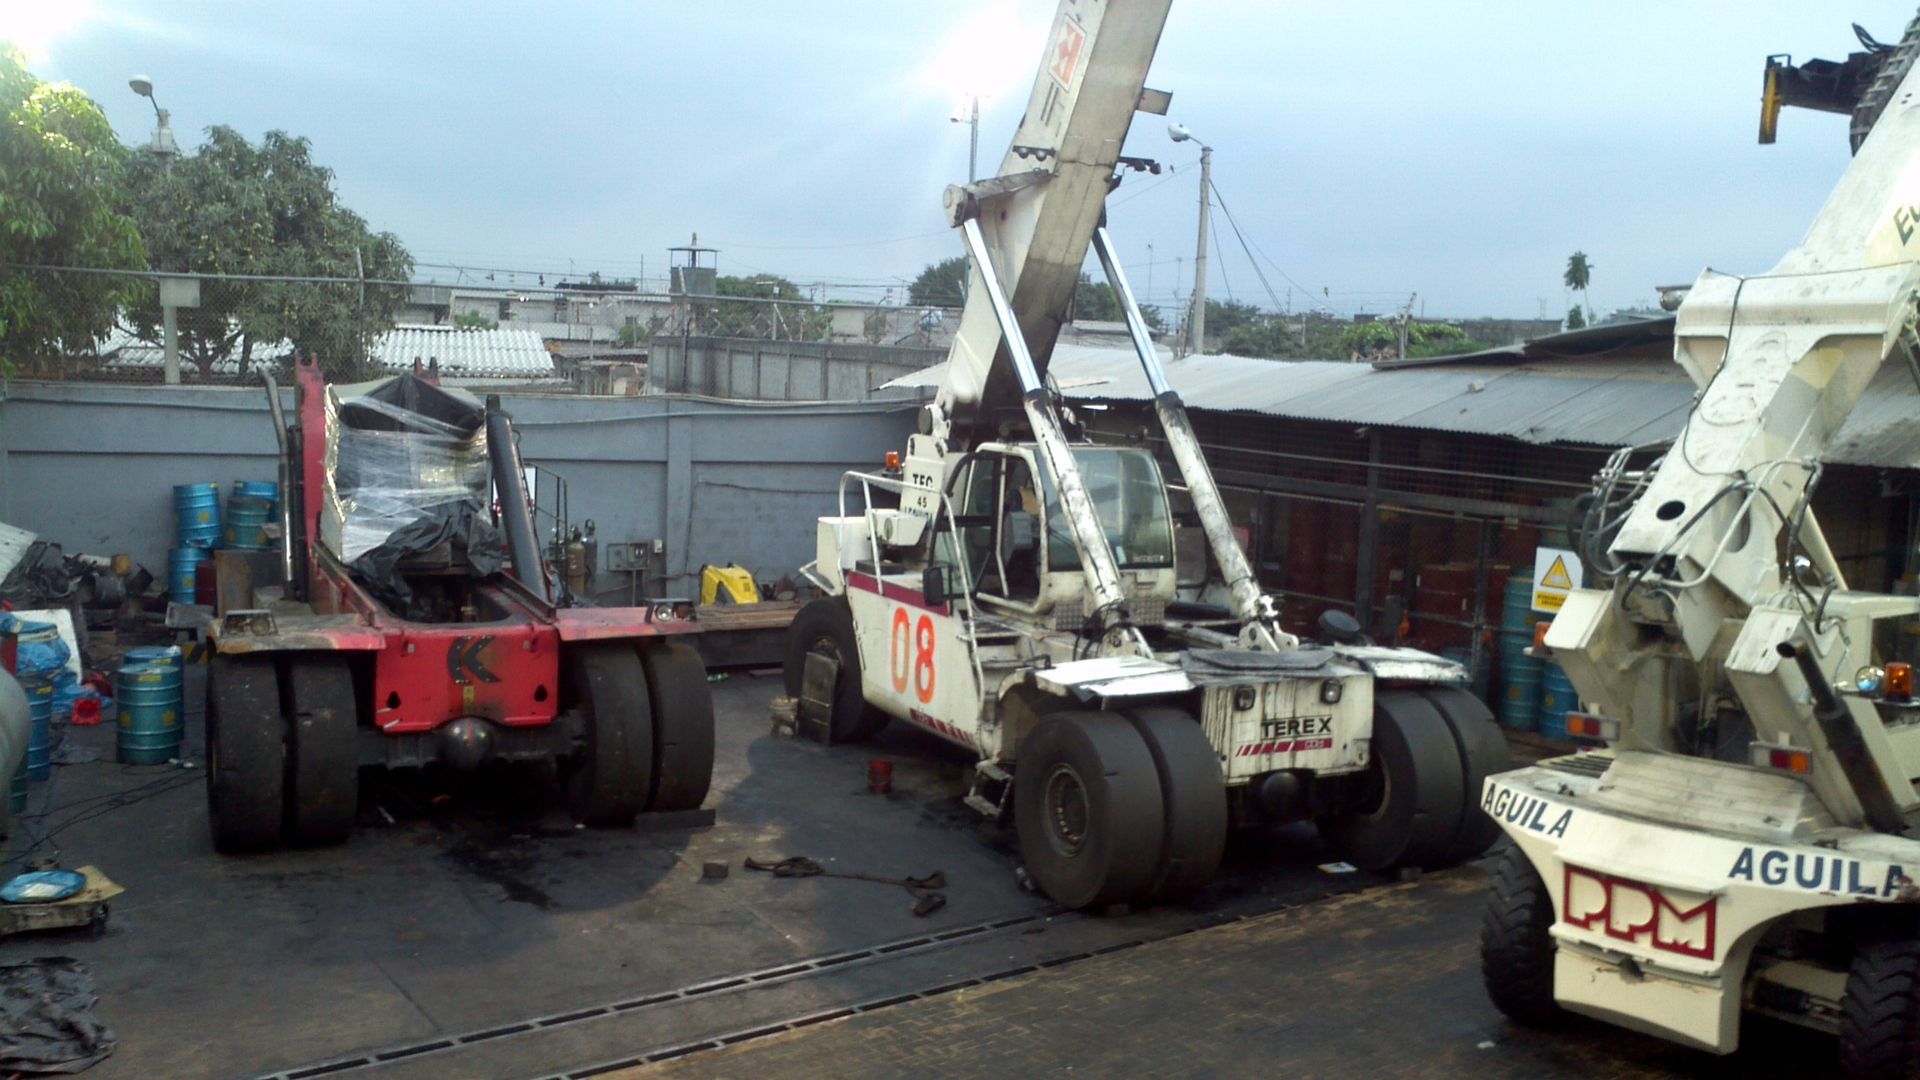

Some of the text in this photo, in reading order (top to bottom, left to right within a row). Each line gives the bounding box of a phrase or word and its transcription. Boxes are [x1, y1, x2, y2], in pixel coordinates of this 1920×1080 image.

[917, 496, 928, 508] 45
[891, 606, 936, 704] 08
[1261, 717, 1332, 738] TEREX
[1482, 782, 1574, 839] AGUILA
[1728, 846, 1907, 898] AGUILA
[1563, 861, 1718, 961] PPM
